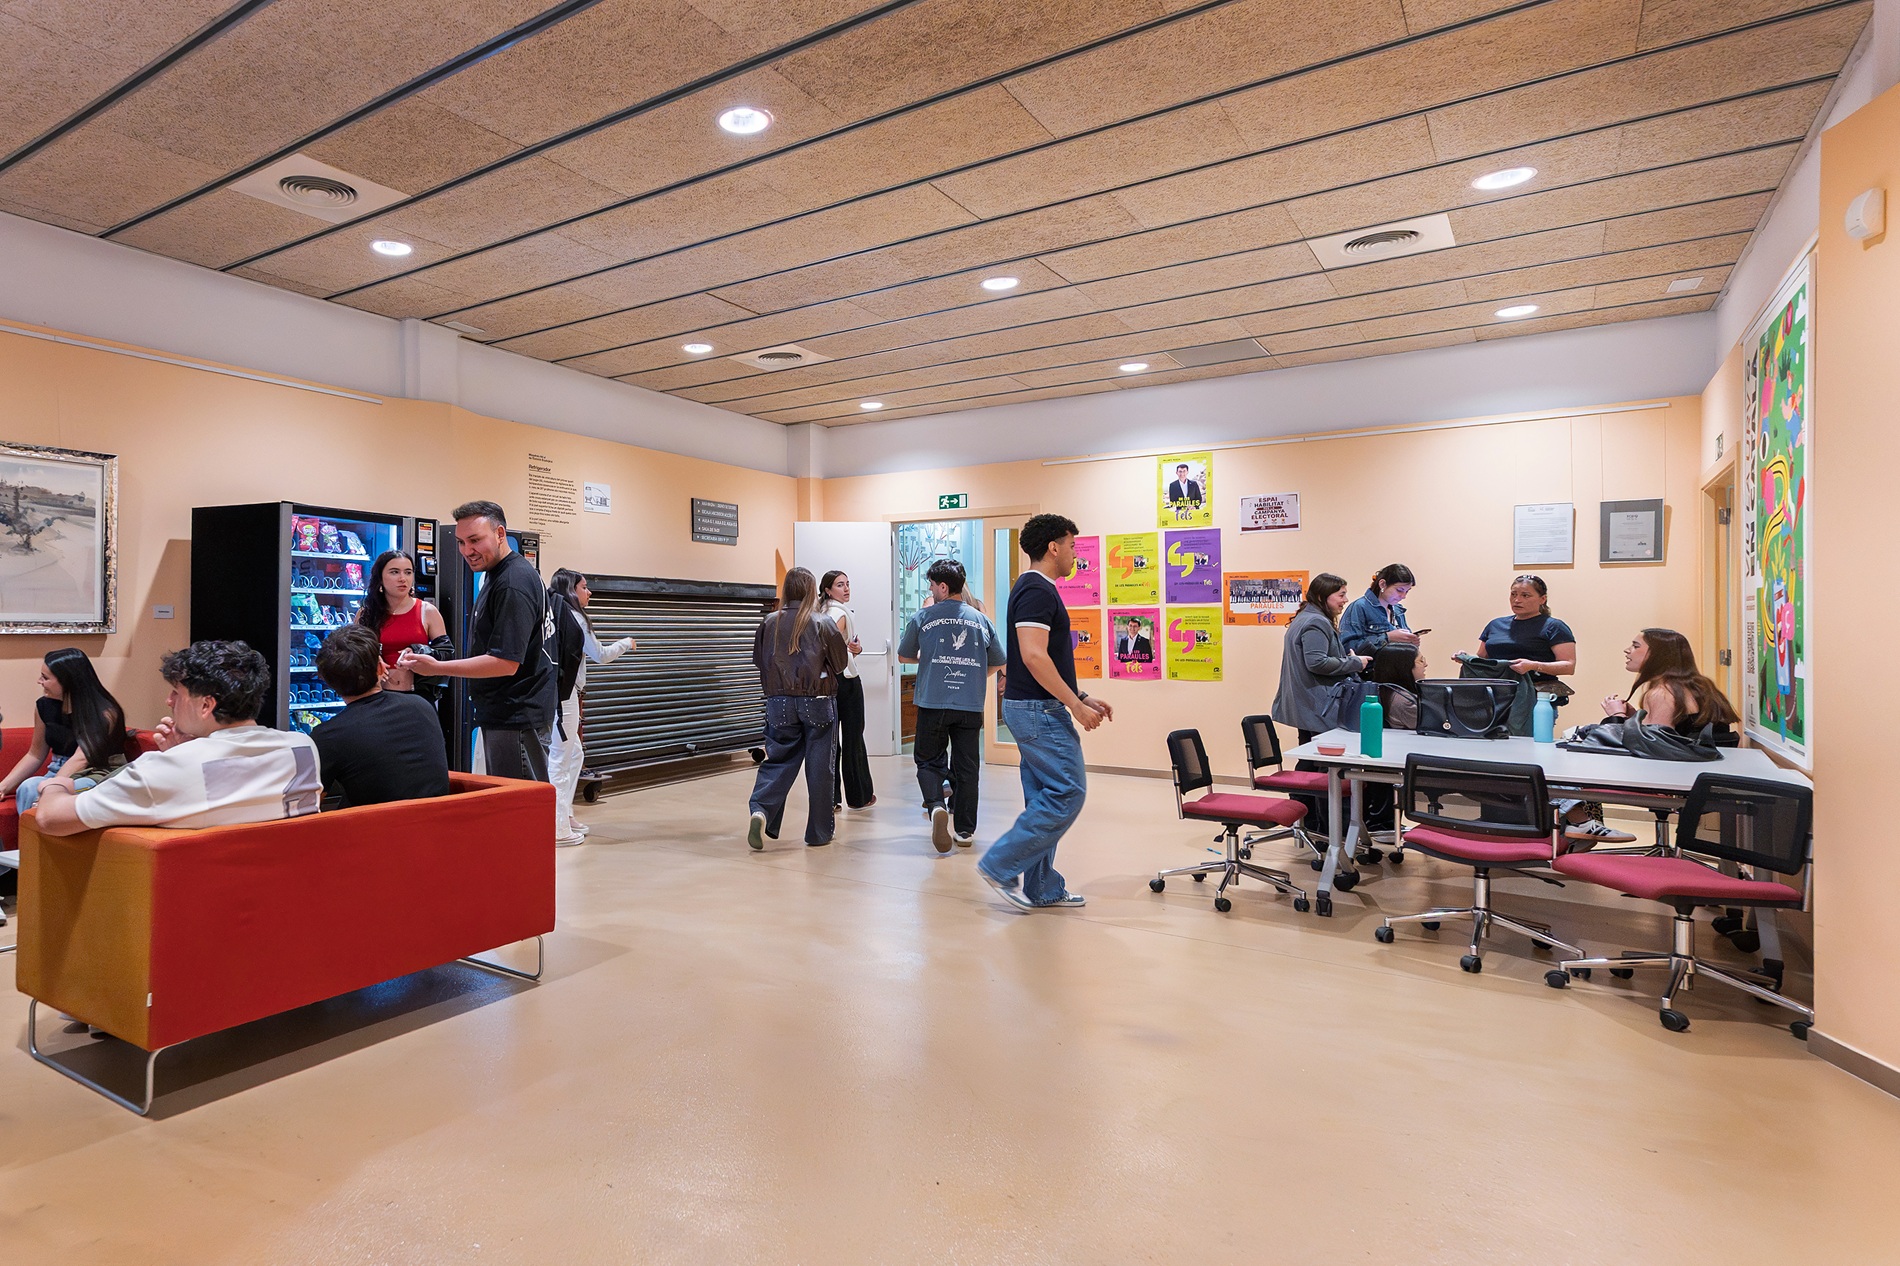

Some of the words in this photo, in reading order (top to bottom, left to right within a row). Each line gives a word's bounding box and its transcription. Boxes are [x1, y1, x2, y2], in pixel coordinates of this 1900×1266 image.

[1175, 507, 1193, 521] Fets
[1257, 611, 1276, 624] Fets
[921, 618, 963, 632] PERSPECTIVE
[1125, 661, 1143, 673] Fets
